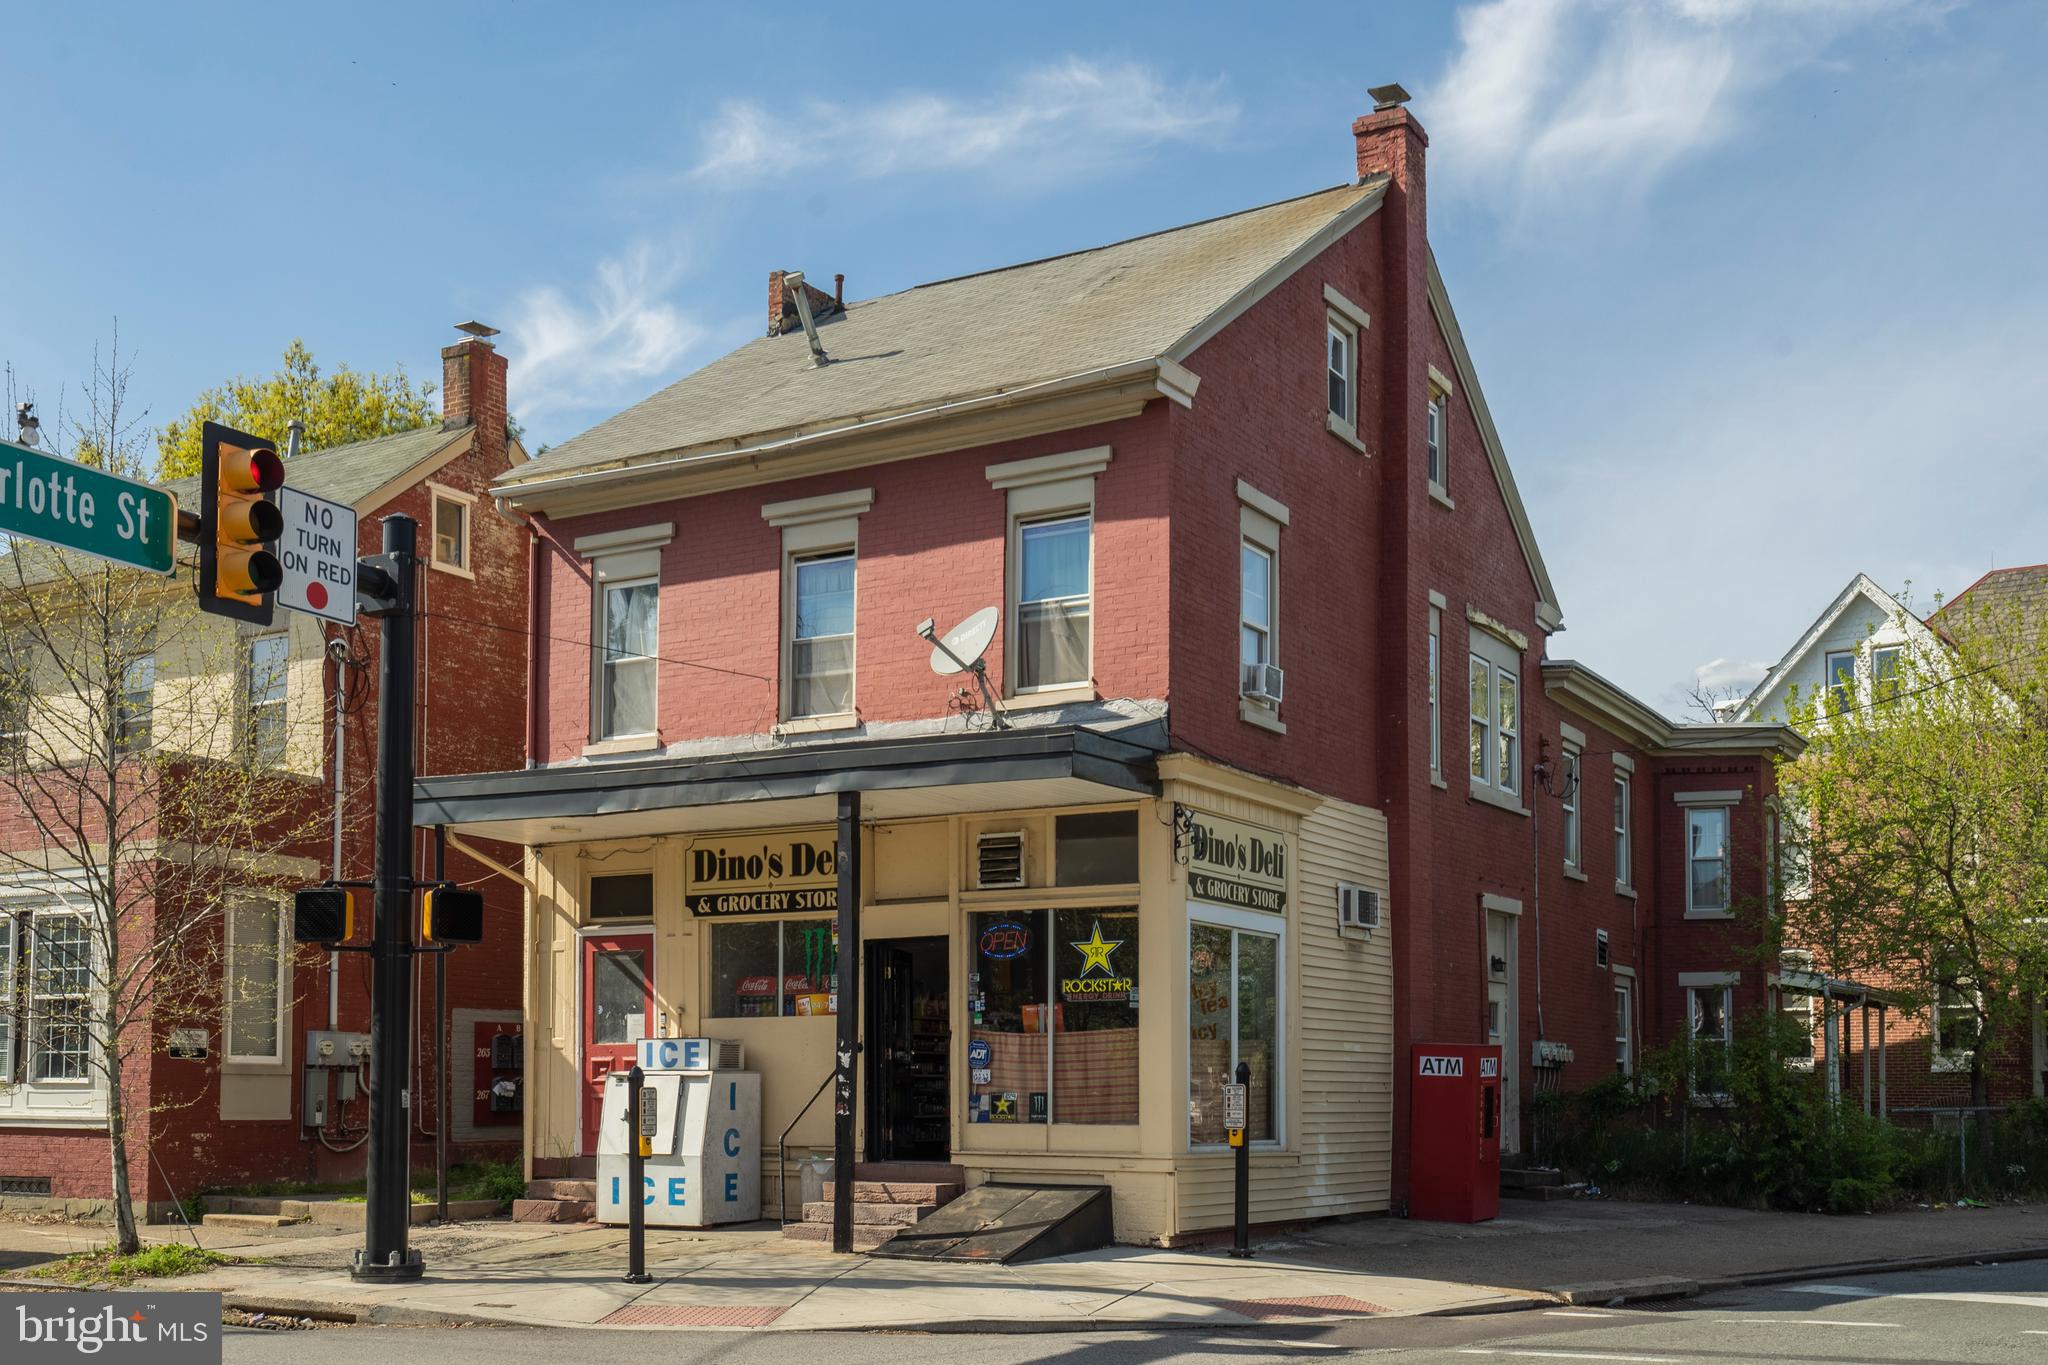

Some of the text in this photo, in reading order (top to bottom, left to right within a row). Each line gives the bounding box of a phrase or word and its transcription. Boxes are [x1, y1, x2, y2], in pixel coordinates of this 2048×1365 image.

[117, 491, 149, 545] St
[305, 502, 333, 530] NO
[296, 528, 341, 559] TURN
[284, 551, 351, 586] ON RED
[692, 841, 838, 883] Dino's Del
[1192, 823, 1284, 879] Dino's Deli
[698, 890, 838, 913] & GROCERY STOR
[1196, 877, 1280, 910] & GROCERY STORE
[980, 930, 1028, 951] OPEN
[476, 1047, 491, 1058] 265
[645, 1041, 700, 1068] ICE
[970, 1048, 988, 1060] ADT
[1421, 1058, 1462, 1075] ATM
[1481, 1059, 1496, 1075] ATM
[476, 1090, 490, 1101] 267
[724, 1082, 741, 1202] ICE
[611, 1176, 687, 1207] ICE
